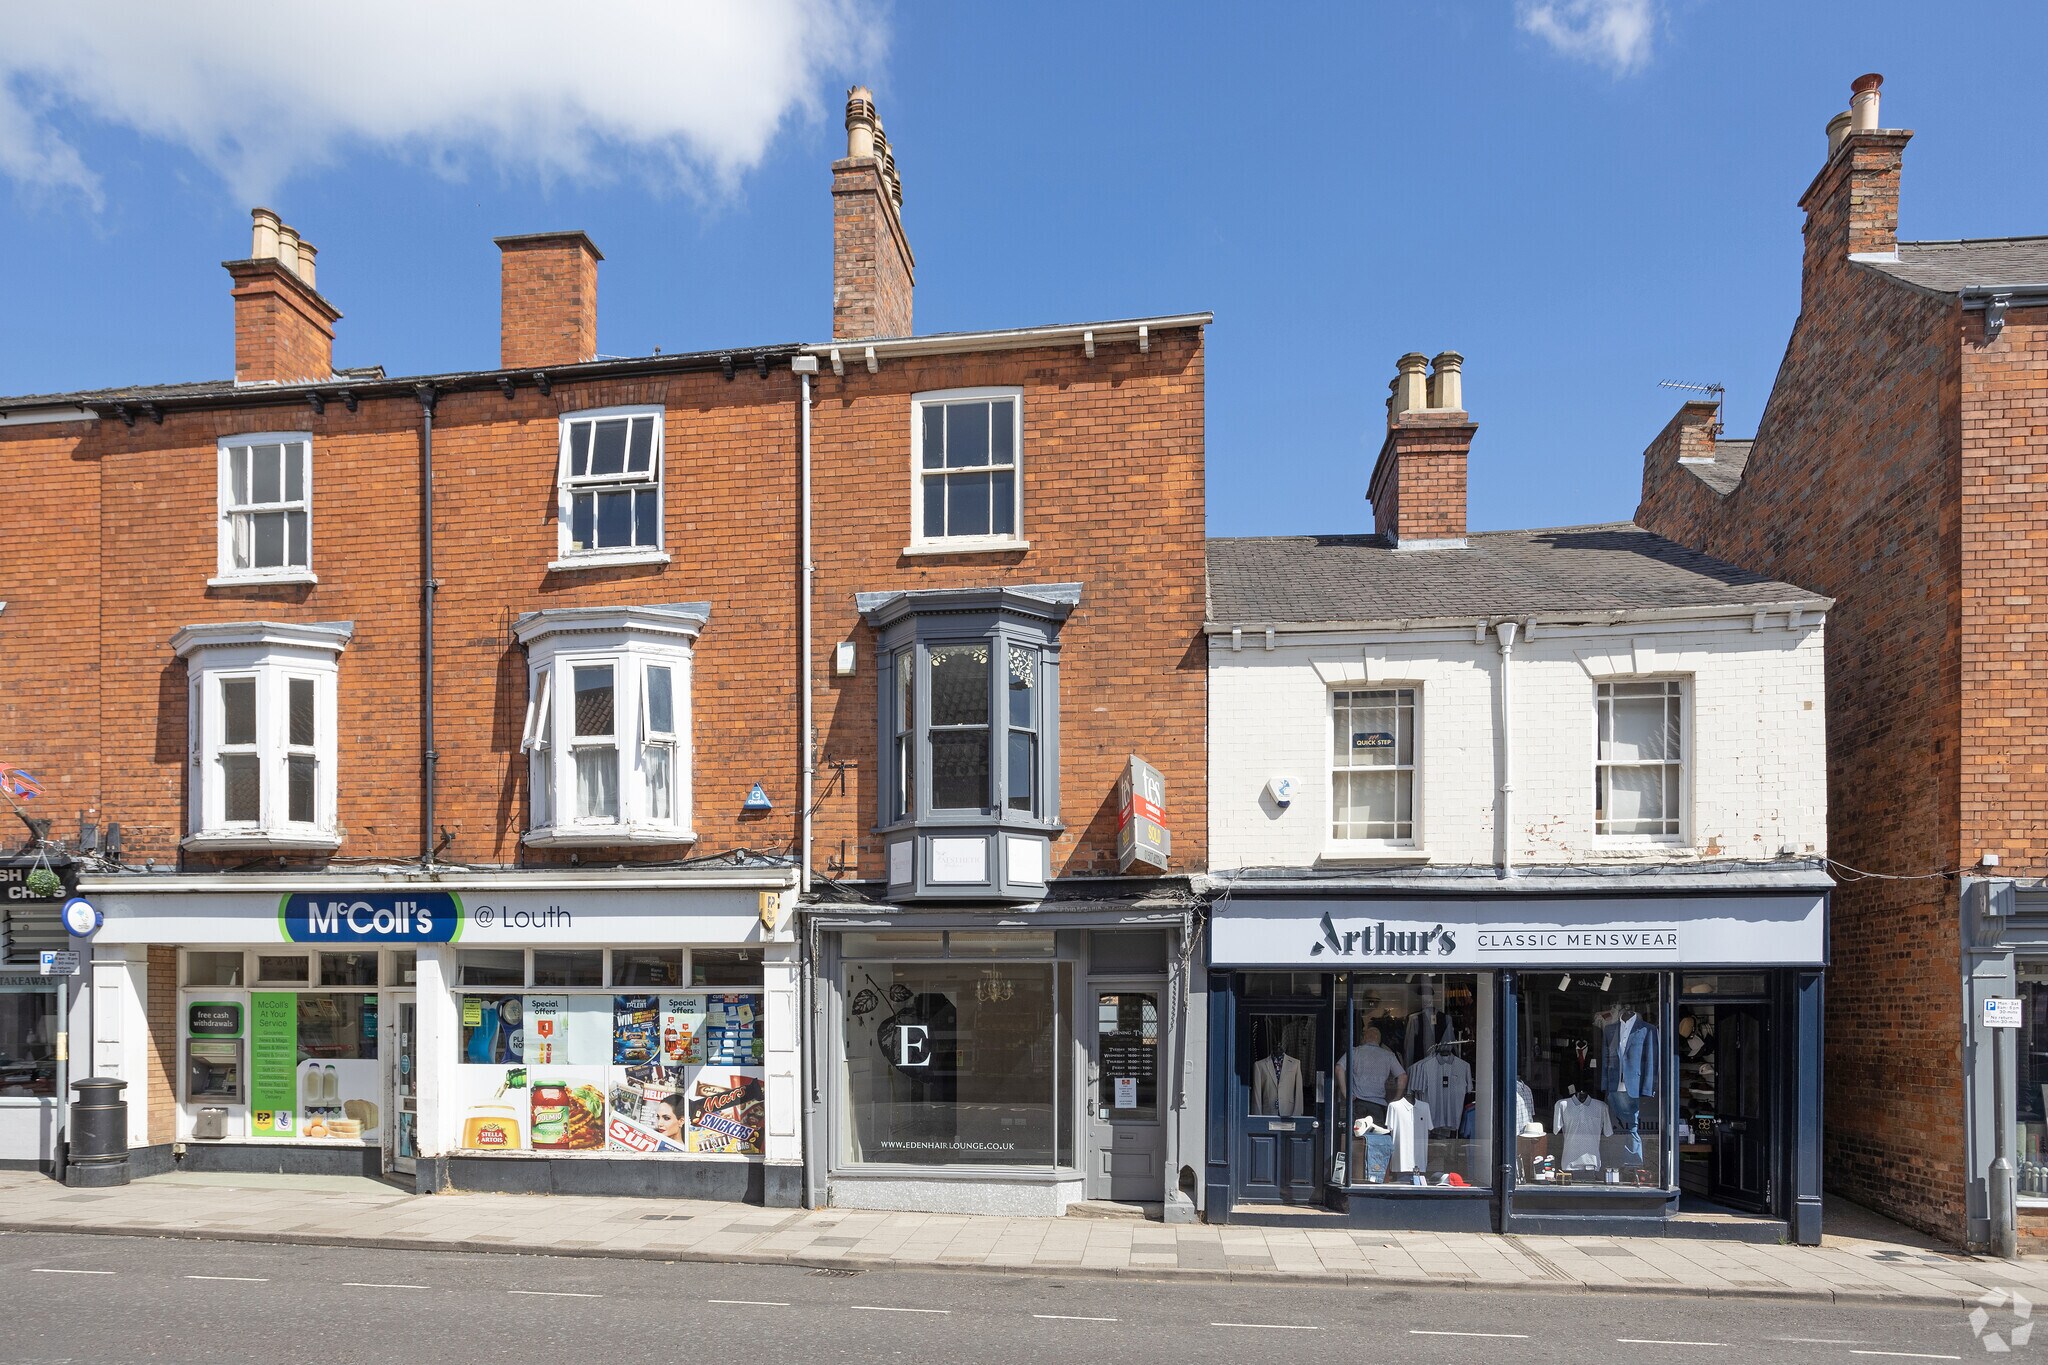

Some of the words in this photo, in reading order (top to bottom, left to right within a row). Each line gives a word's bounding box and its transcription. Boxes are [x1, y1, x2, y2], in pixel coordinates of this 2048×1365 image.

[1142, 766, 1161, 808] tes
[1148, 824, 1161, 845] SOLD
[8, 886, 67, 899] CHS
[308, 901, 433, 934] McColl's
[474, 905, 495, 928] @
[503, 906, 571, 928] Louth
[1310, 911, 1457, 956] Arthur's
[1477, 934, 1557, 947] CLASSIC
[1567, 933, 1679, 947] MENSWEAR
[0, 977, 53, 985] TAKEAWAY
[258, 1001, 289, 1009] McColl's
[531, 1000, 558, 1008] Special
[534, 1007, 556, 1015] offers
[668, 1000, 697, 1009] Special
[259, 1019, 288, 1027] Service
[616, 1013, 633, 1027] WIN
[895, 1025, 931, 1066] E
[703, 1086, 747, 1113] Mars
[700, 1114, 753, 1140] SNICKERS
[609, 1121, 656, 1152] Sun
[881, 1141, 1014, 1150] WWW.EDENHAIRLOUNGE.CO.UK
